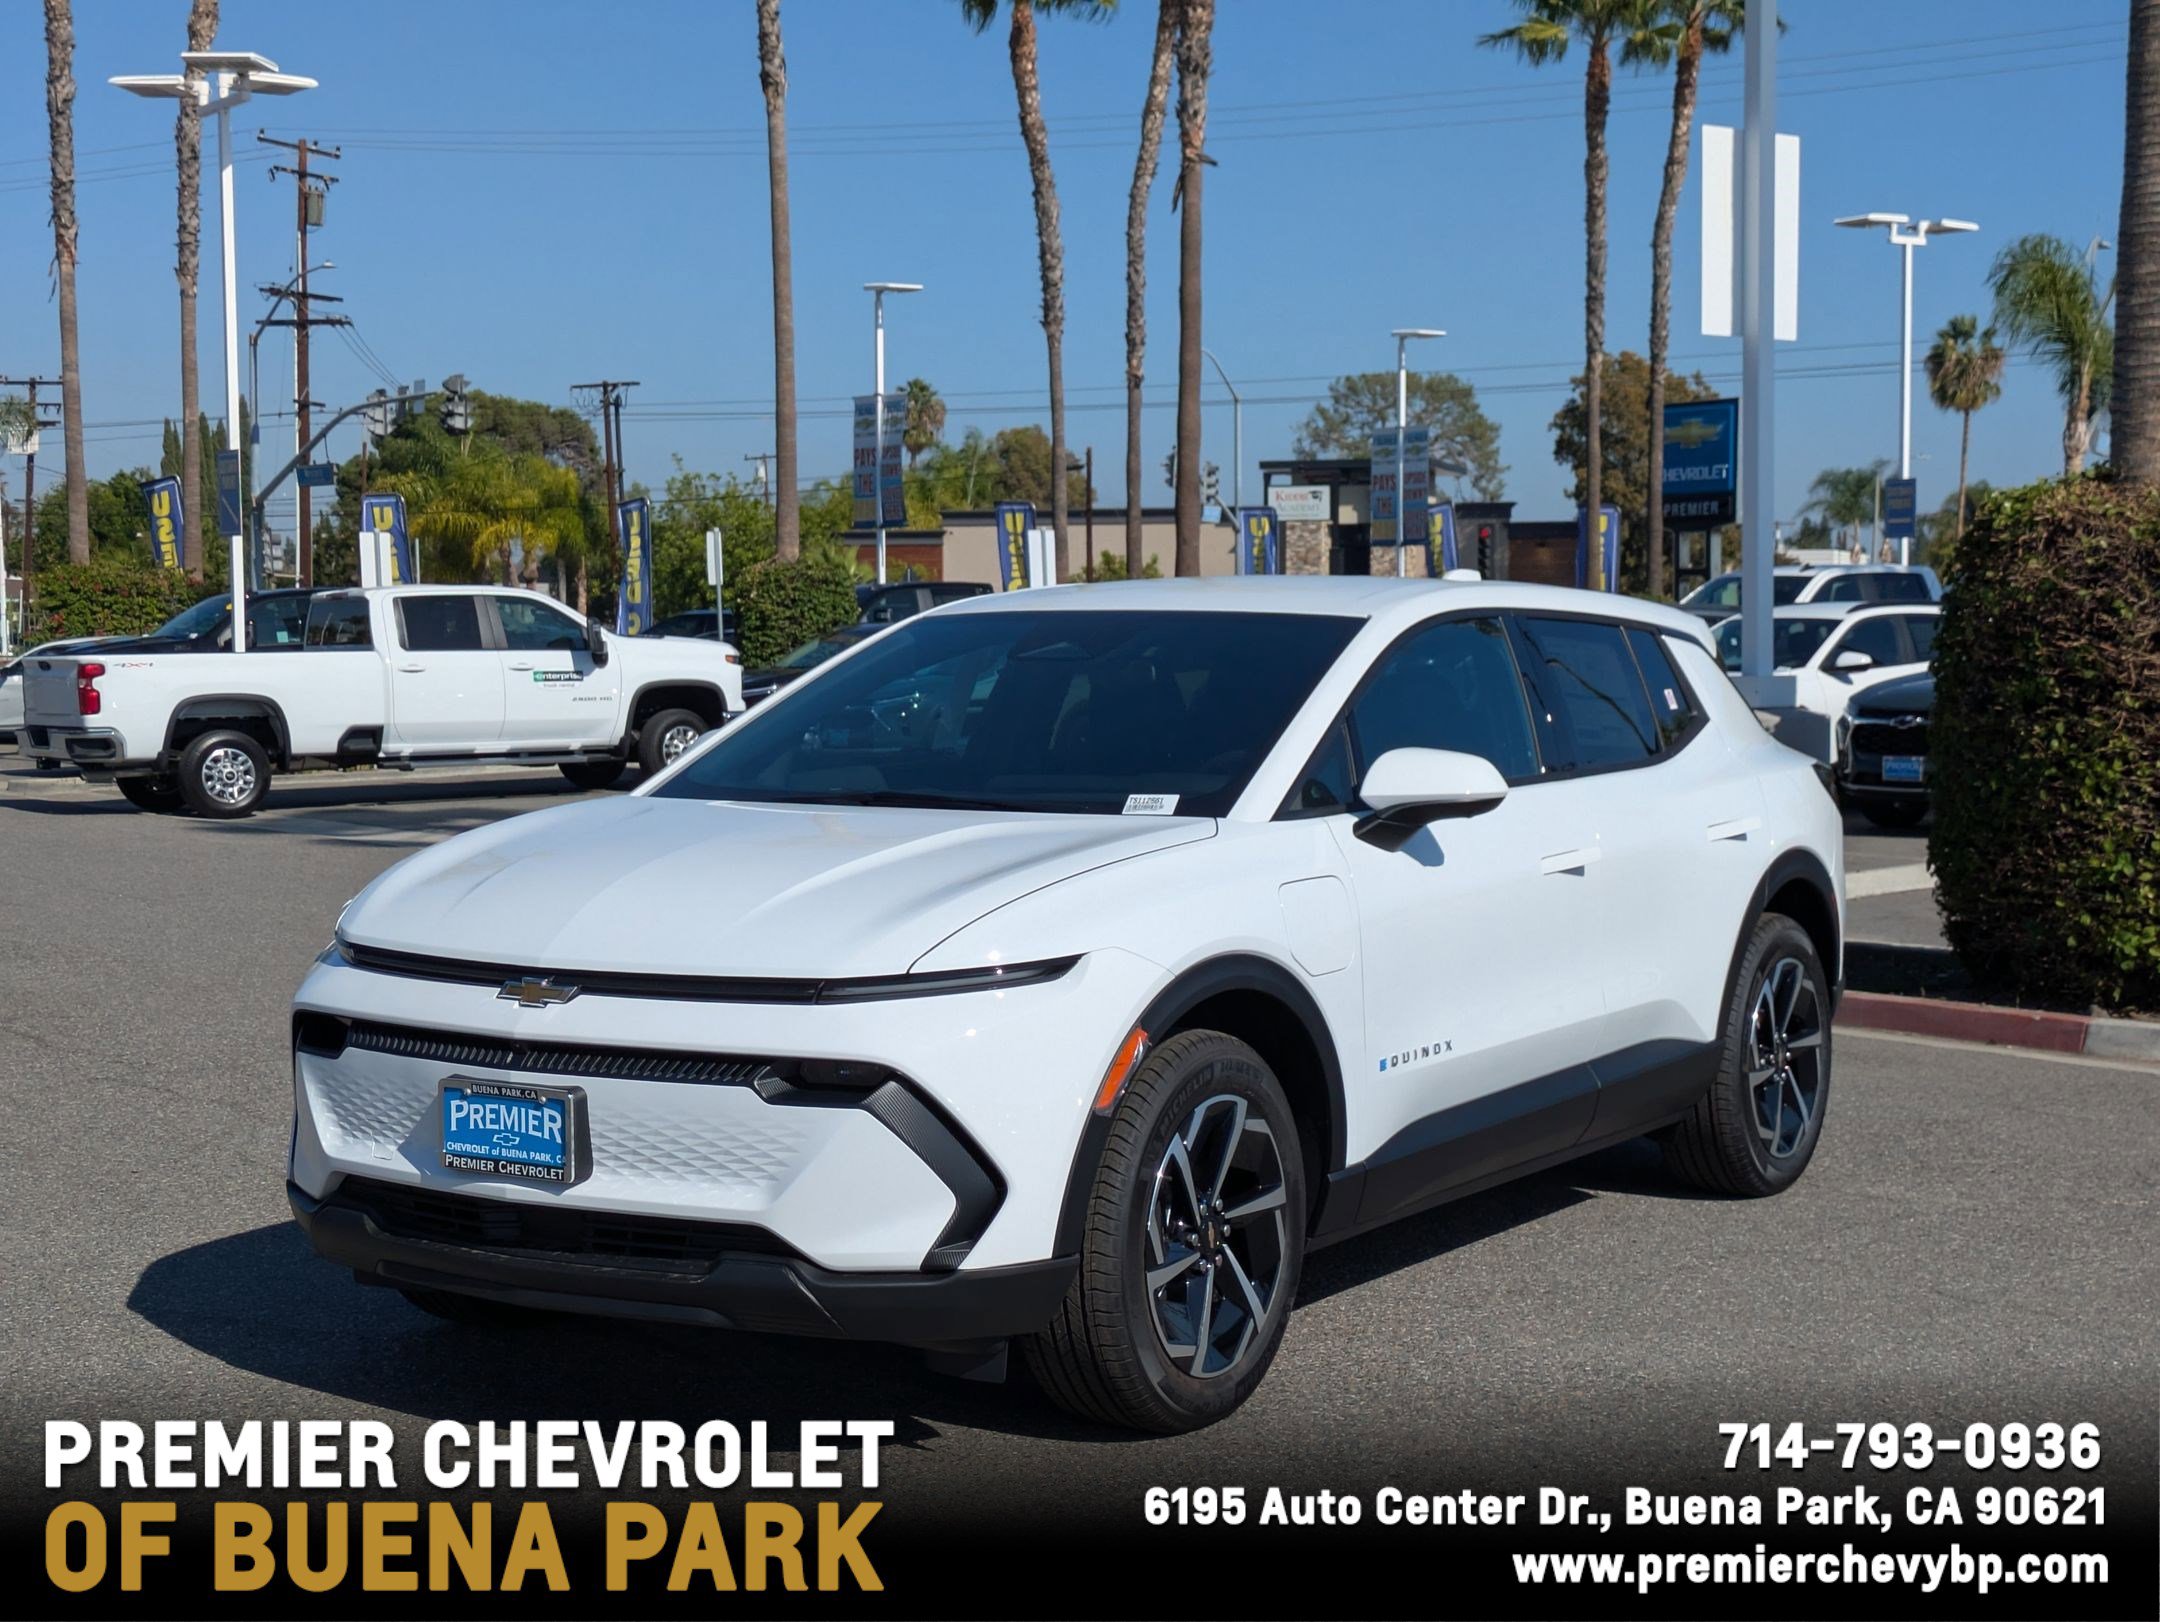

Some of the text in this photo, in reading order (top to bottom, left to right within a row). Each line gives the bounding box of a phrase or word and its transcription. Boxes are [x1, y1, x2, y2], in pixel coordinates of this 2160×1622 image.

[1663, 464, 1728, 483] HEVROLET
[472, 1084, 499, 1095] BUENA
[450, 1099, 562, 1144] PREMIER
[446, 1141, 490, 1155] CHEVROLET
[491, 1147, 500, 1156] of
[501, 1148, 528, 1159] BUENA
[445, 1155, 564, 1180] PREMIER CHEVROLET
